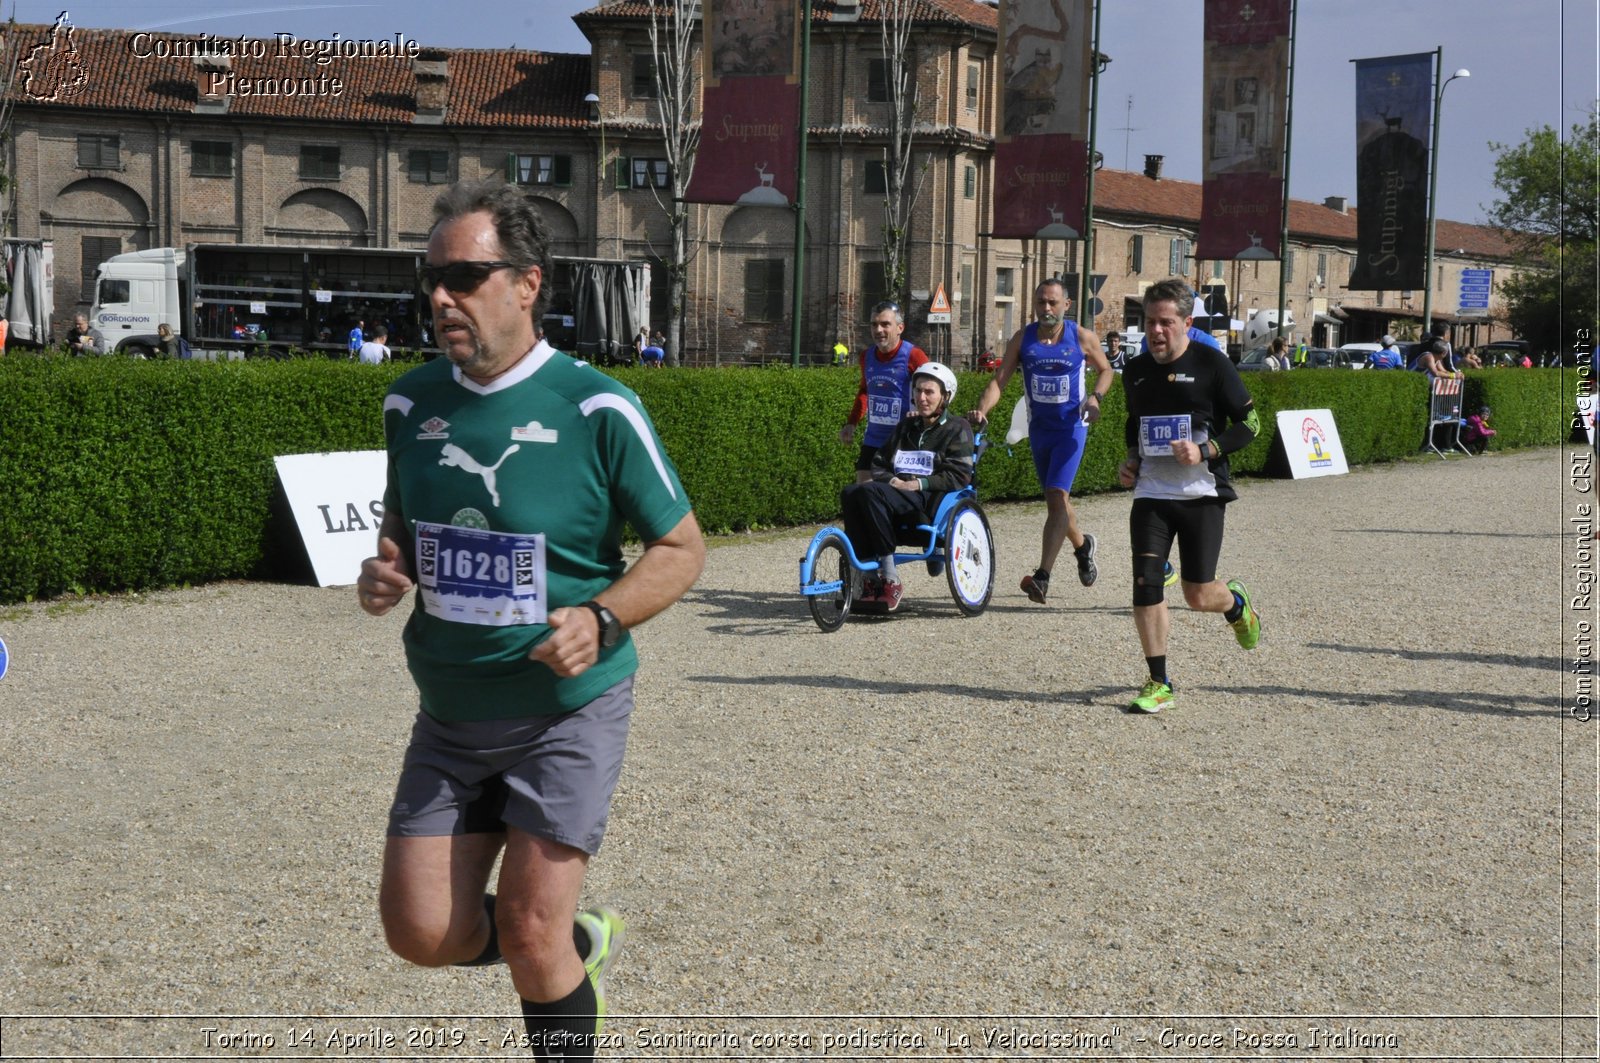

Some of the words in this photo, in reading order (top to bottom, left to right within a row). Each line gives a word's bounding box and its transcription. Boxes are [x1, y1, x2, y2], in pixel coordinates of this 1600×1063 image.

[1368, 169, 1405, 276] Stupinigi
[102, 315, 150, 323] BORDIGNON
[1041, 382, 1056, 392] 721
[875, 402, 888, 412] 720
[1153, 425, 1172, 439] 178
[904, 457, 925, 467] 3344
[440, 548, 510, 584] 1628
